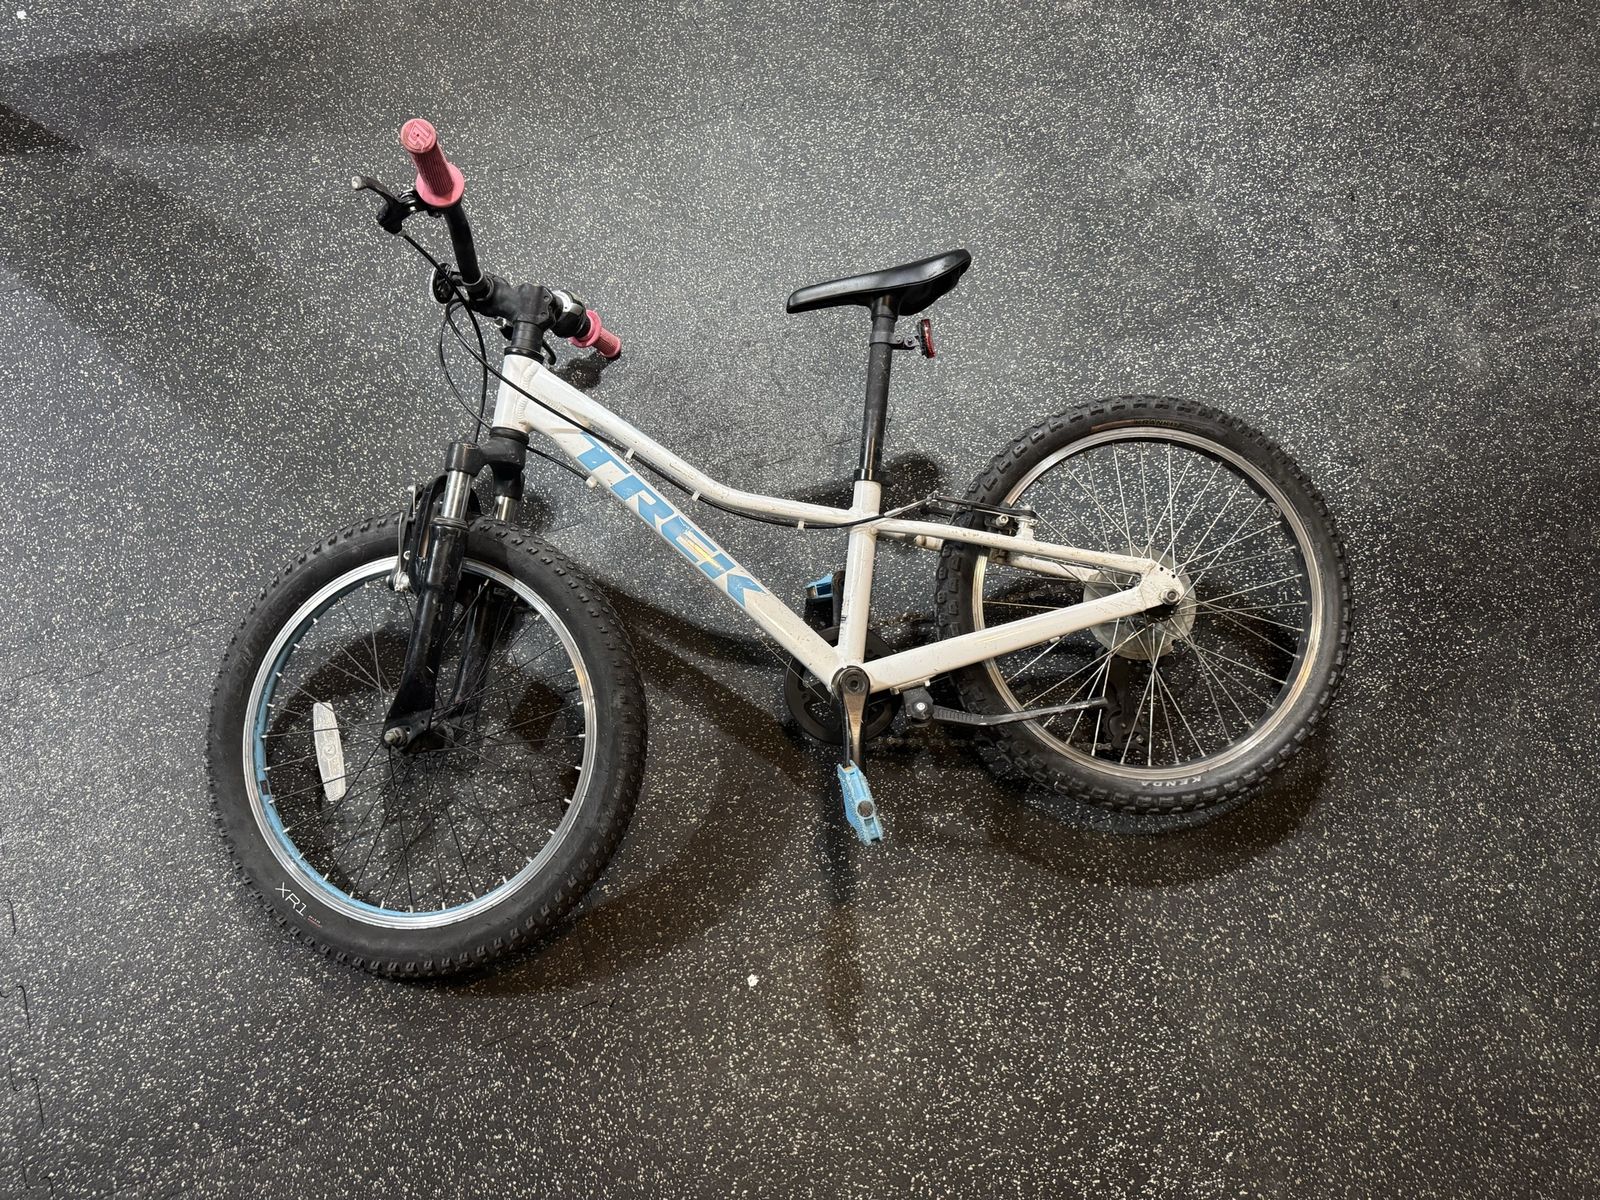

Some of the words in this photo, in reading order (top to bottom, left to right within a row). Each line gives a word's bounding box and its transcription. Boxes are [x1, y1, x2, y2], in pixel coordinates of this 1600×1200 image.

[577, 431, 767, 608] TREK
[1141, 776, 1201, 787] KENDA
[275, 882, 307, 917] XR1
